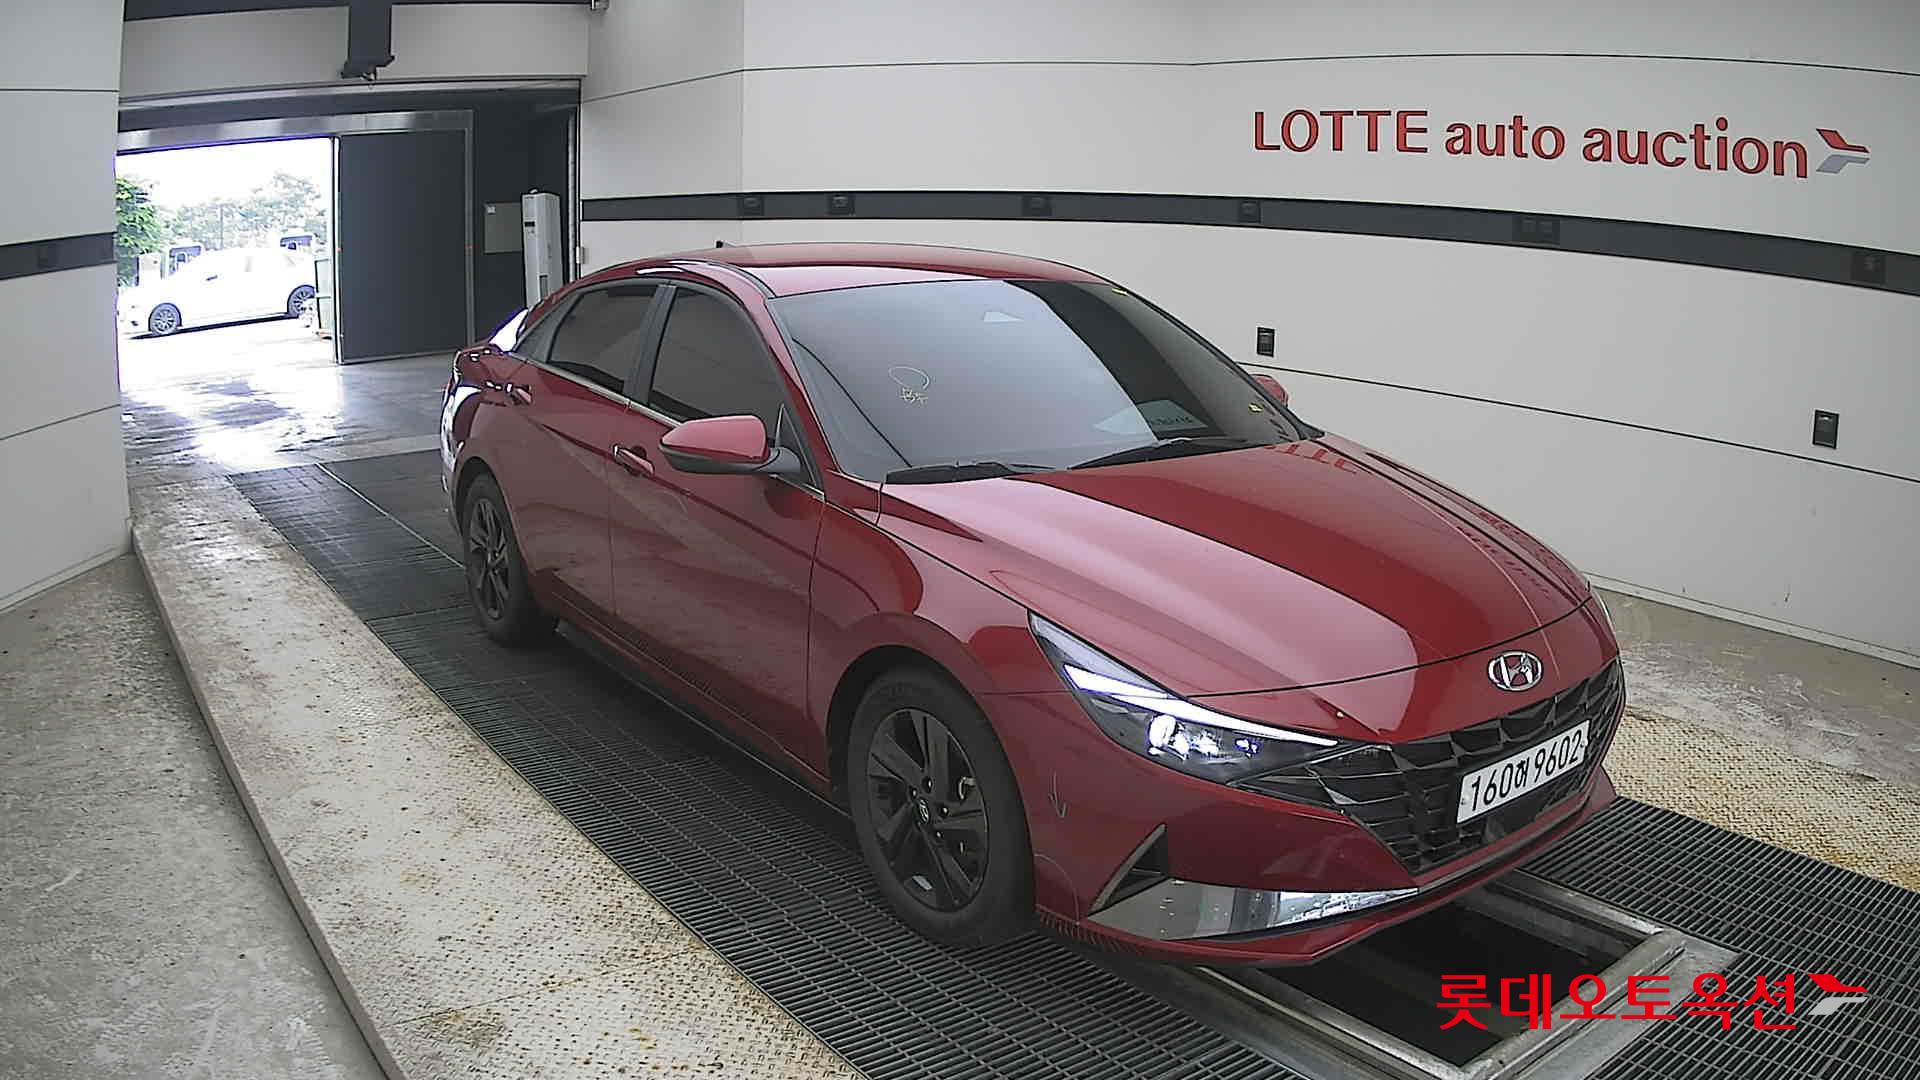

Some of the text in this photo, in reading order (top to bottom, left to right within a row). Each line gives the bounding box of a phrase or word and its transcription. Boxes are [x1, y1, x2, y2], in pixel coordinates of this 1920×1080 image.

[1253, 110, 1809, 178] LOTTE auto auction
